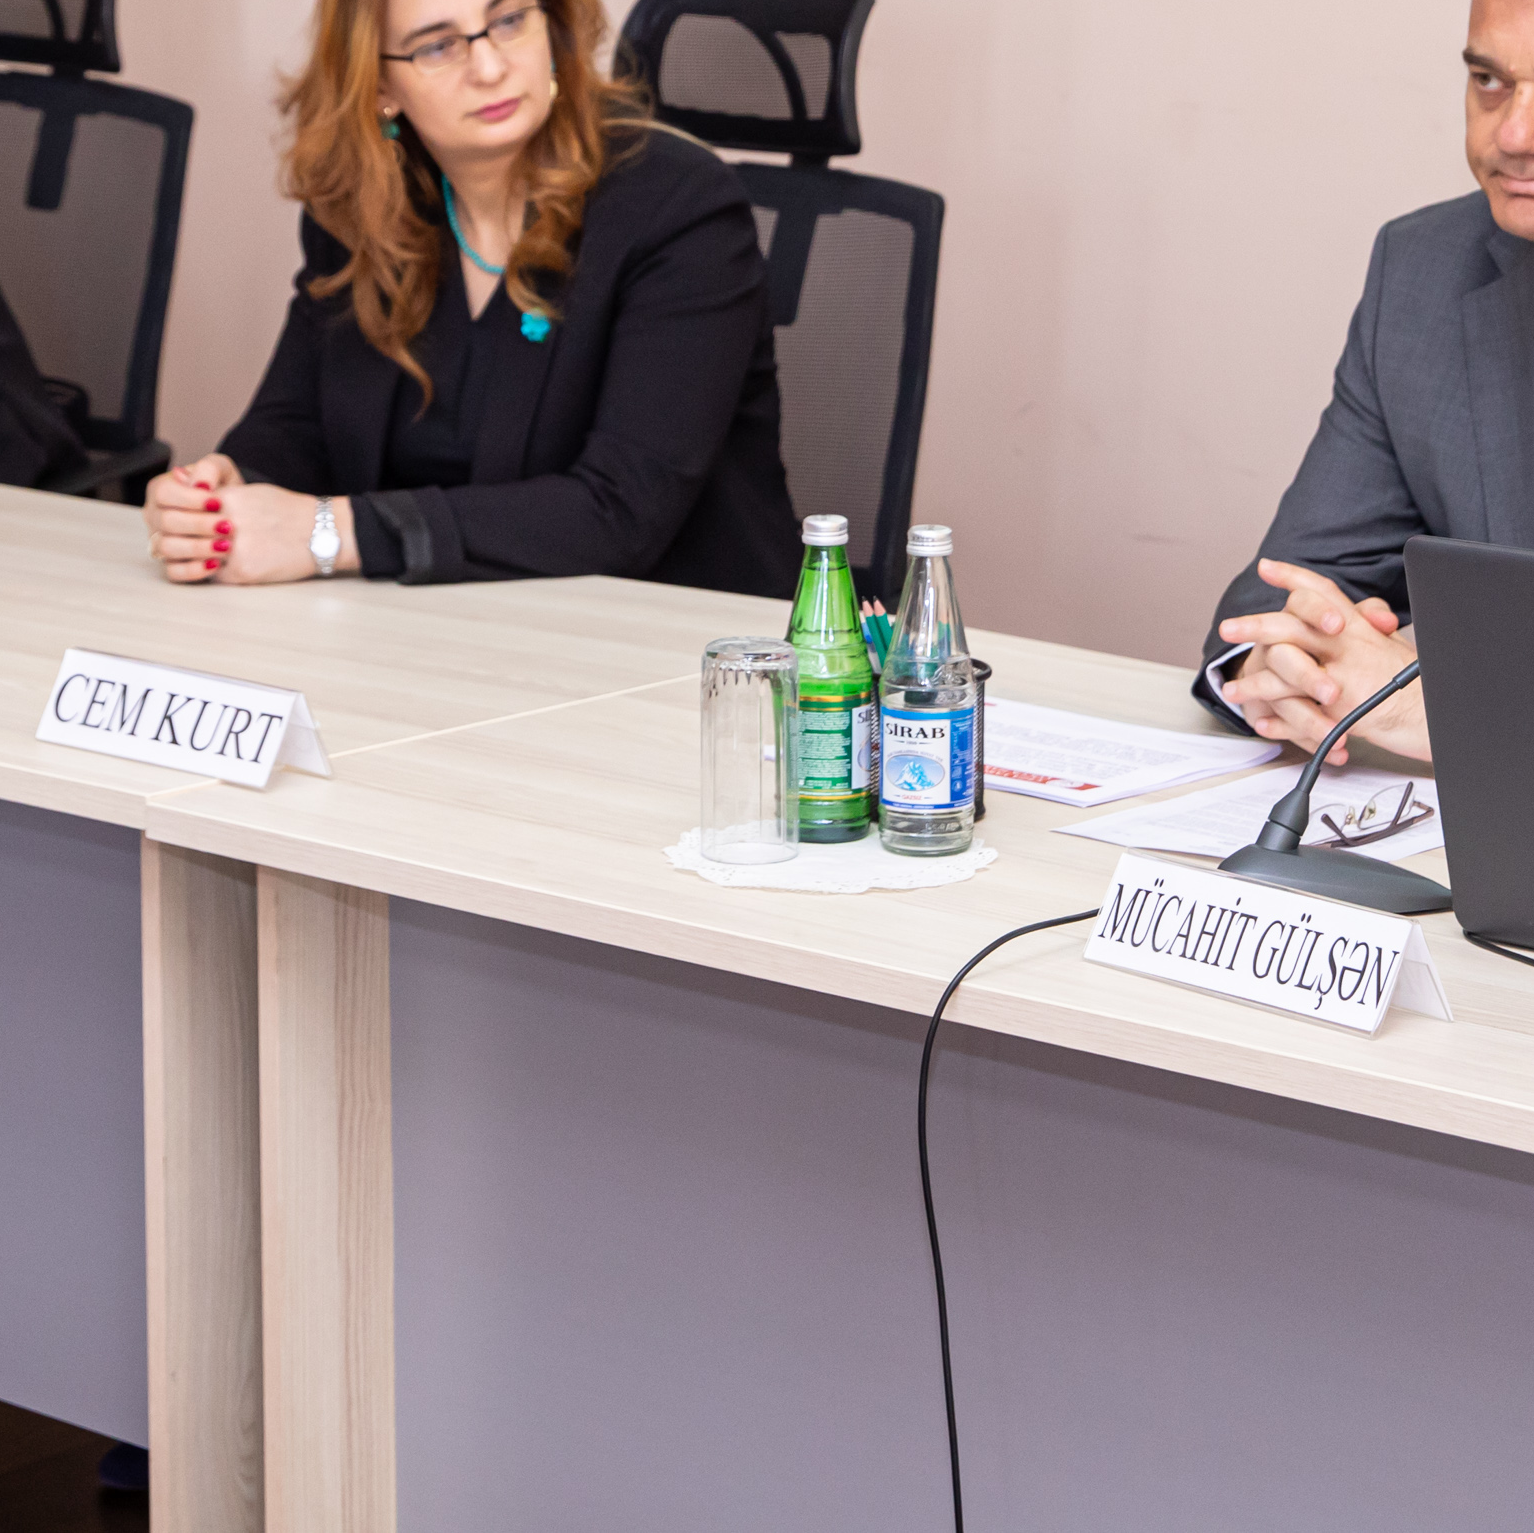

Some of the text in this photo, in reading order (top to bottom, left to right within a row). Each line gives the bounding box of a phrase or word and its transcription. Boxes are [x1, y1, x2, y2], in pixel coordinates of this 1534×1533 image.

[54, 673, 283, 765] CEM KURT
[885, 722, 945, 739] SİRAB
[1097, 878, 1400, 1011] MÜCAHİT GÜLŞƏN
